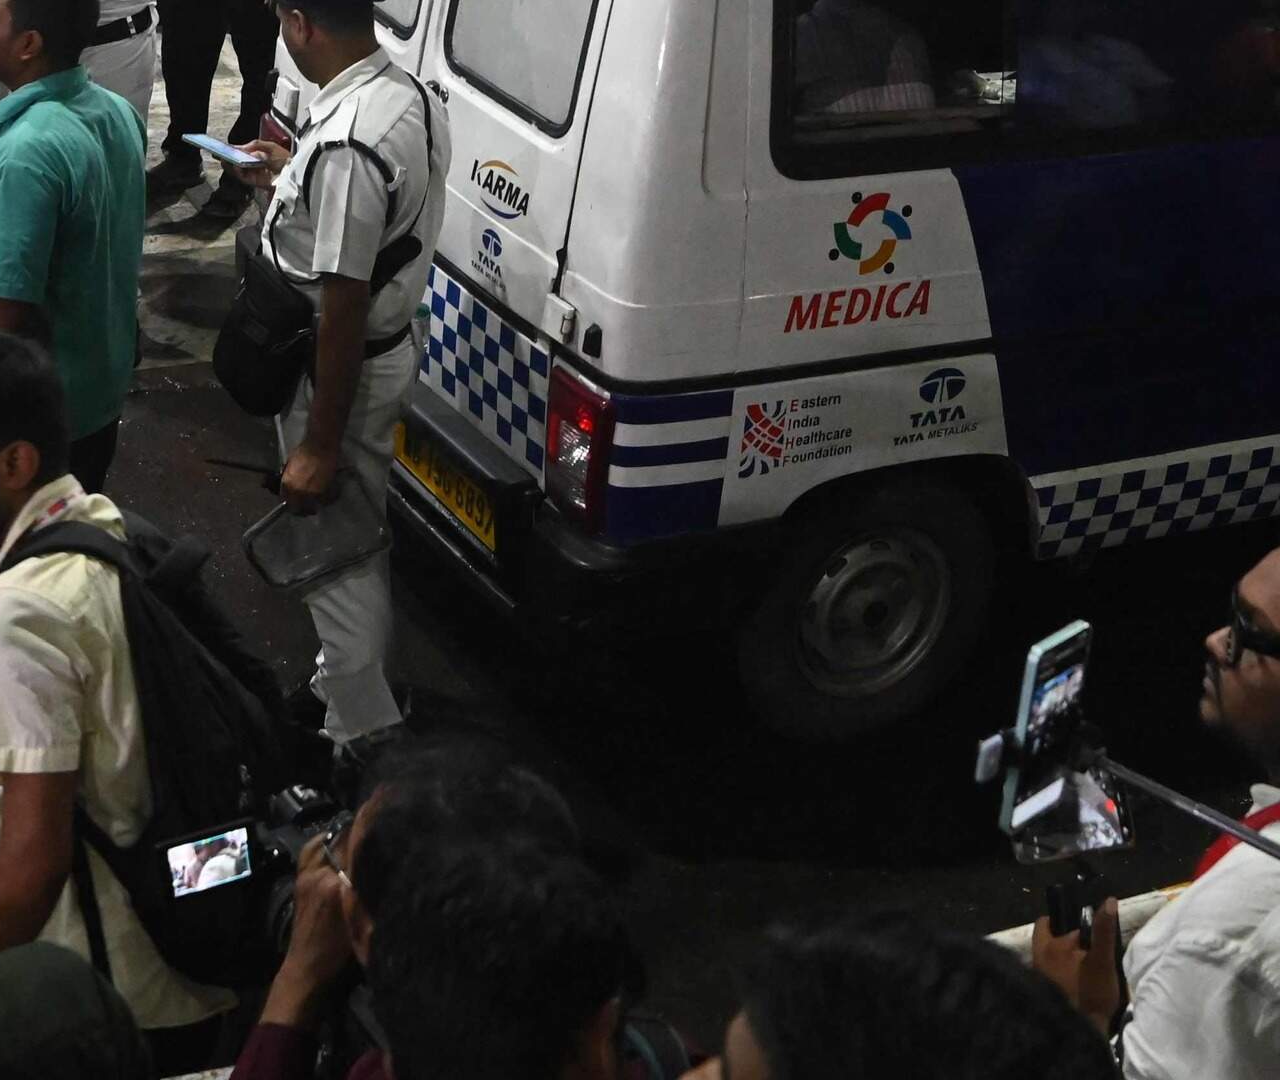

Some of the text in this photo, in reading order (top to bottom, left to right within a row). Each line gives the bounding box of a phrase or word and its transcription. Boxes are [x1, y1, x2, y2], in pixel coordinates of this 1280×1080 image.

[470, 159, 530, 217] KARMA
[478, 250, 502, 278] TATA
[783, 279, 931, 334] MEDICA
[790, 394, 841, 413] Eastern
[787, 416, 820, 432] India
[910, 405, 966, 428] TATA
[784, 427, 852, 450] Healthcare
[893, 422, 978, 446] TATA METALIKS
[782, 444, 852, 468] Foundation
